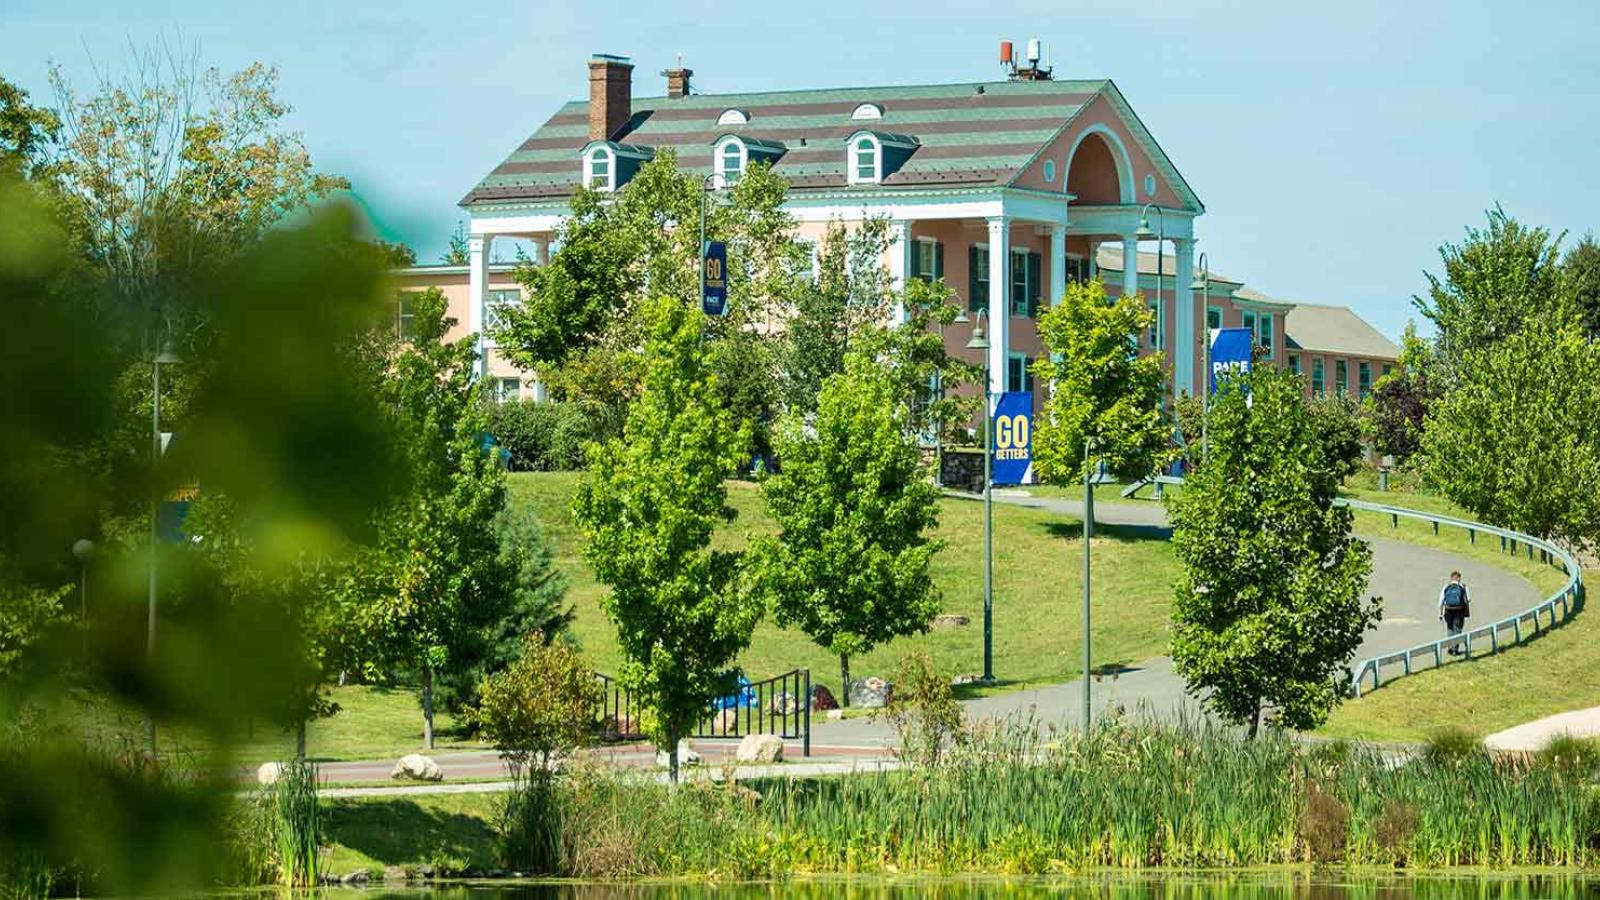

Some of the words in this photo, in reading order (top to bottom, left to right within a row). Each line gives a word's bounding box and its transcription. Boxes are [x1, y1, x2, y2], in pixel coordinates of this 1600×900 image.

[706, 258, 721, 279] GO
[996, 414, 1029, 449] GO
[996, 448, 1029, 460] GETTERS
